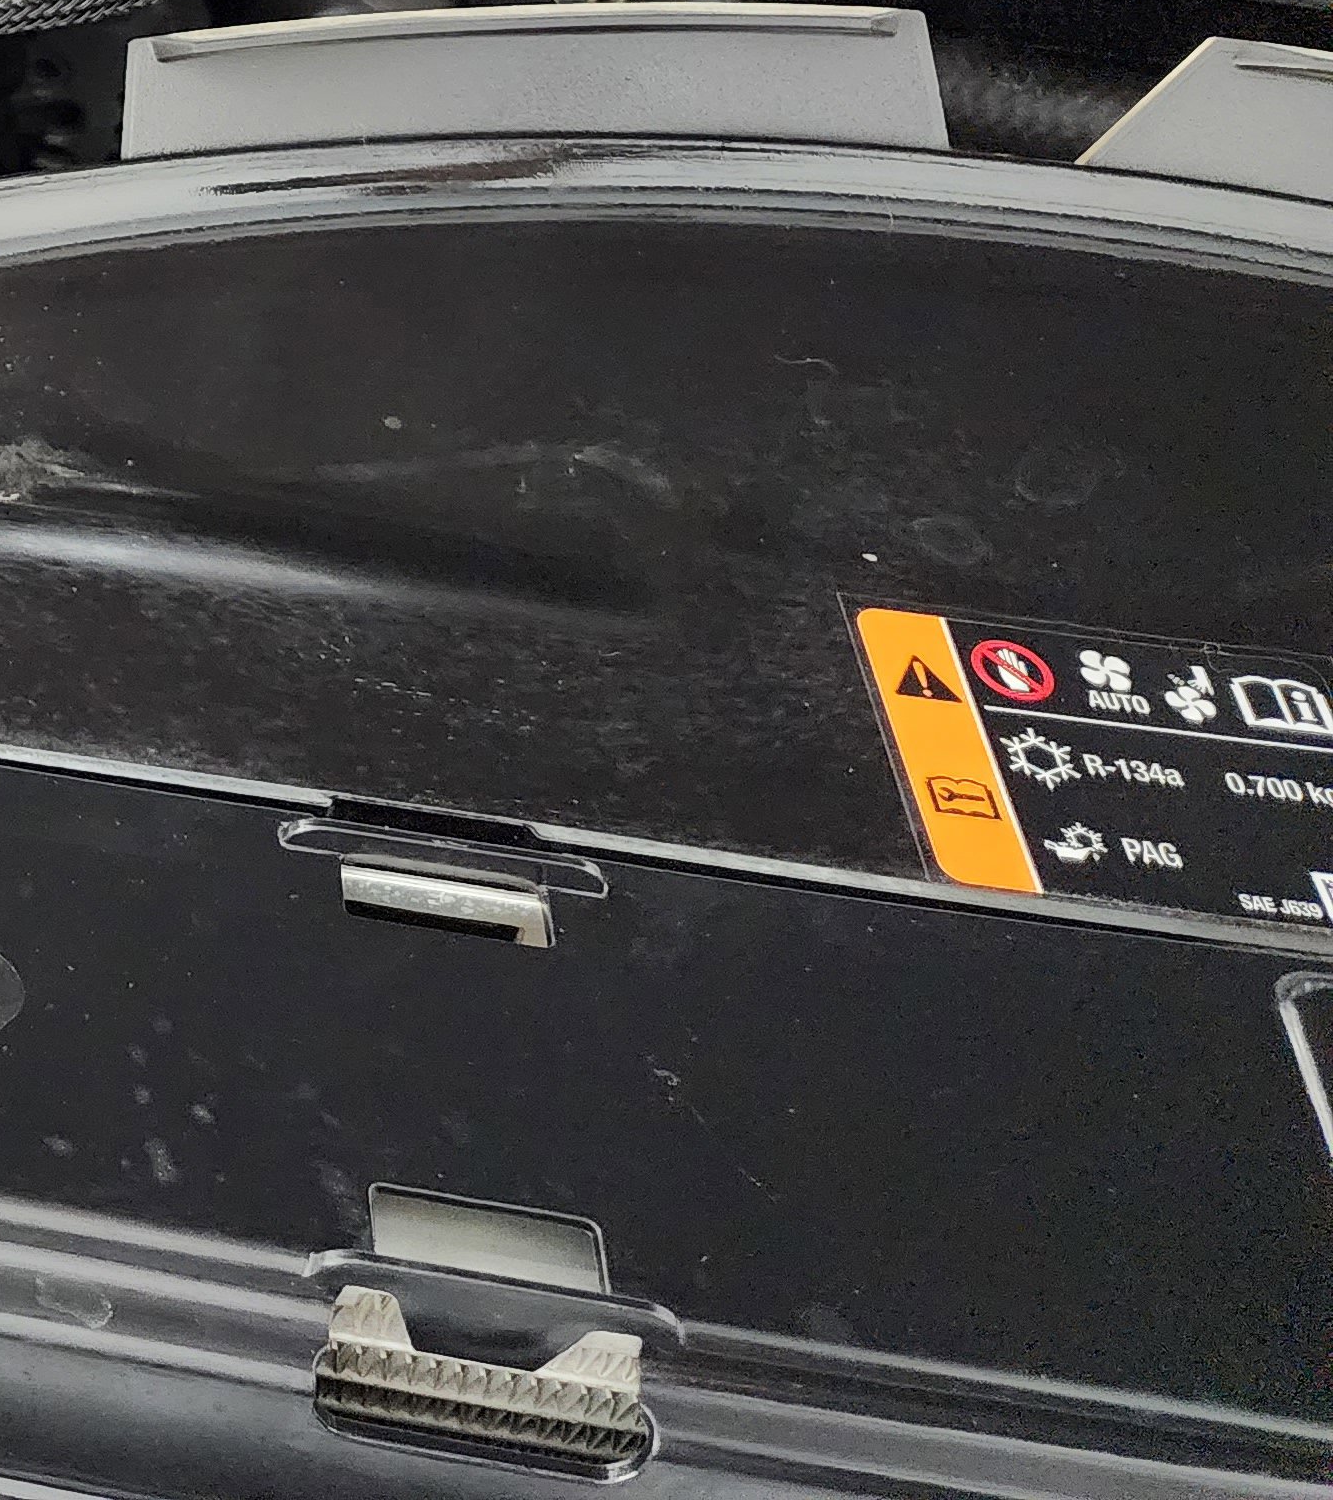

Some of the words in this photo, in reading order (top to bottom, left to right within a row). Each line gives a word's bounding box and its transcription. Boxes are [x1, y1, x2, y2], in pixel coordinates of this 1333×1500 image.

[1087, 690, 1152, 717] AUTO
[1083, 753, 1186, 788] R-134a
[1224, 771, 1304, 802] 0.700
[1120, 837, 1184, 870] PAG
[1237, 893, 1278, 914] SAE
[1279, 898, 1324, 920] J639
